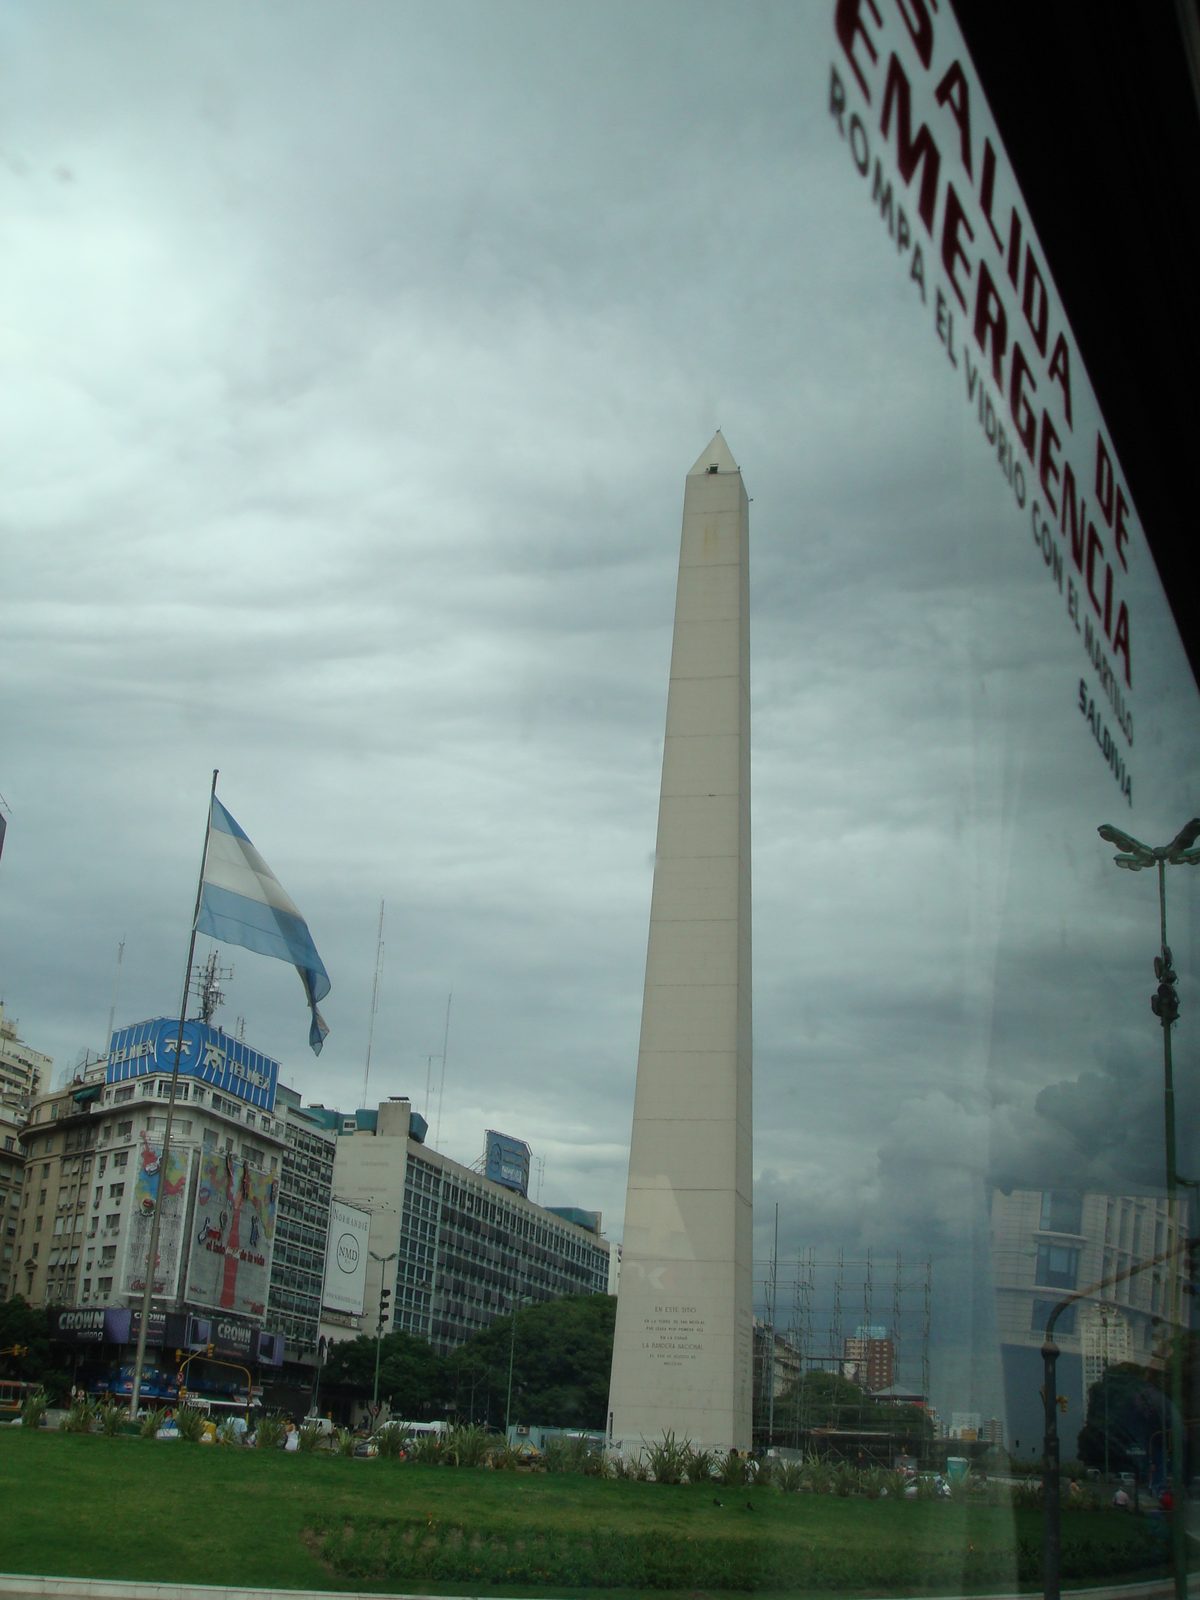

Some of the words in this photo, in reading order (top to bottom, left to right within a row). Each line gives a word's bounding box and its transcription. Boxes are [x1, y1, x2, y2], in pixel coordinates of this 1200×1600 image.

[898, 0, 1073, 432] SALIDA
[1095, 429, 1130, 575] DE
[834, 0, 1132, 690] EMERGENCIA
[828, 61, 926, 306] ROMPA
[935, 285, 958, 370] EL
[964, 344, 1026, 510] VIDRIO
[1031, 499, 1064, 595] CON
[1067, 575, 1081, 634] EL
[1084, 614, 1134, 748] MARTILLO
[338, 1246, 358, 1262] NMD
[58, 1311, 105, 1330] CROWN
[134, 1312, 166, 1322] COWN
[217, 1323, 252, 1344] CROWN
